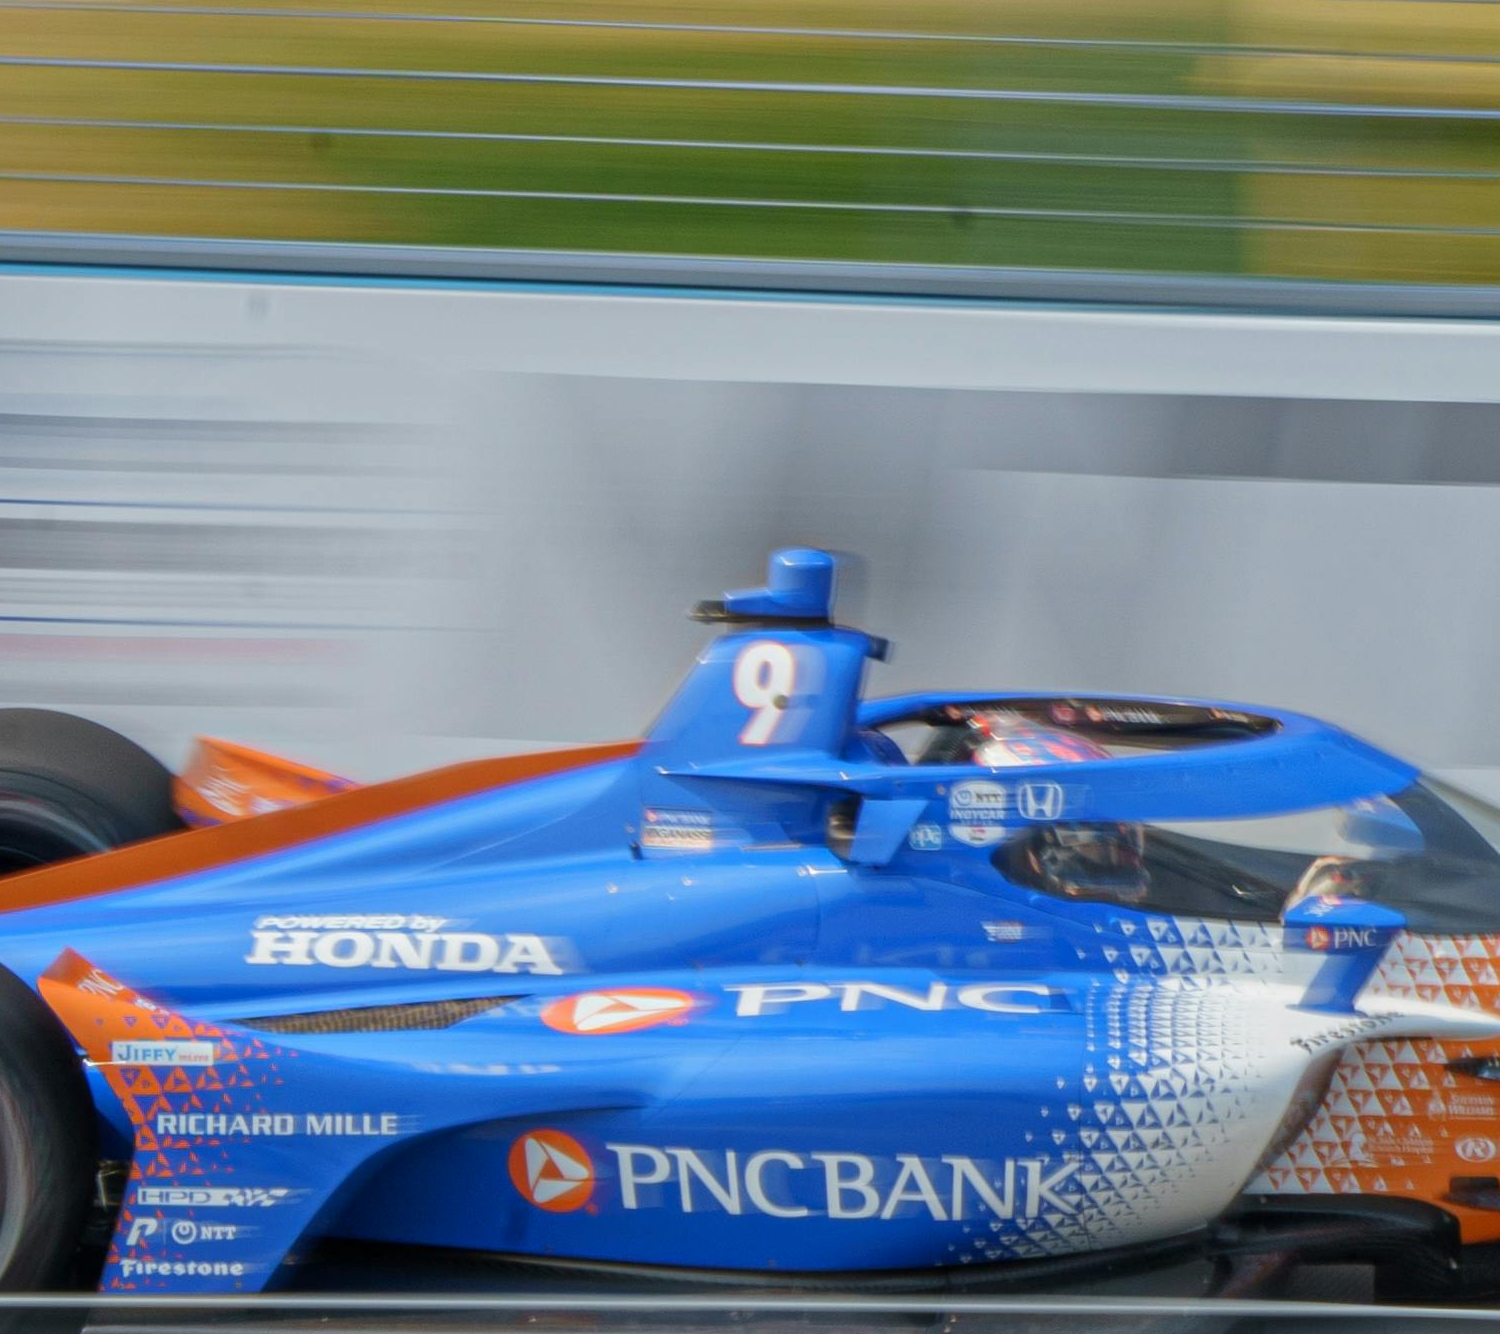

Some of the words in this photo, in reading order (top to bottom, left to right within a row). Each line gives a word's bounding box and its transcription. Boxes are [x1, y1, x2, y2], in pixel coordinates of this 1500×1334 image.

[733, 639, 797, 747] 9
[255, 915, 402, 930] POWERED
[1333, 925, 1378, 950] PNC
[244, 930, 563, 975] HONDA
[723, 981, 1050, 1017] PNC
[157, 1113, 295, 1136] RICHARD
[306, 1113, 398, 1136] MILLE
[141, 1190, 212, 1204] HPD
[200, 1226, 237, 1240] NTT
[119, 1259, 244, 1278] Firestone
